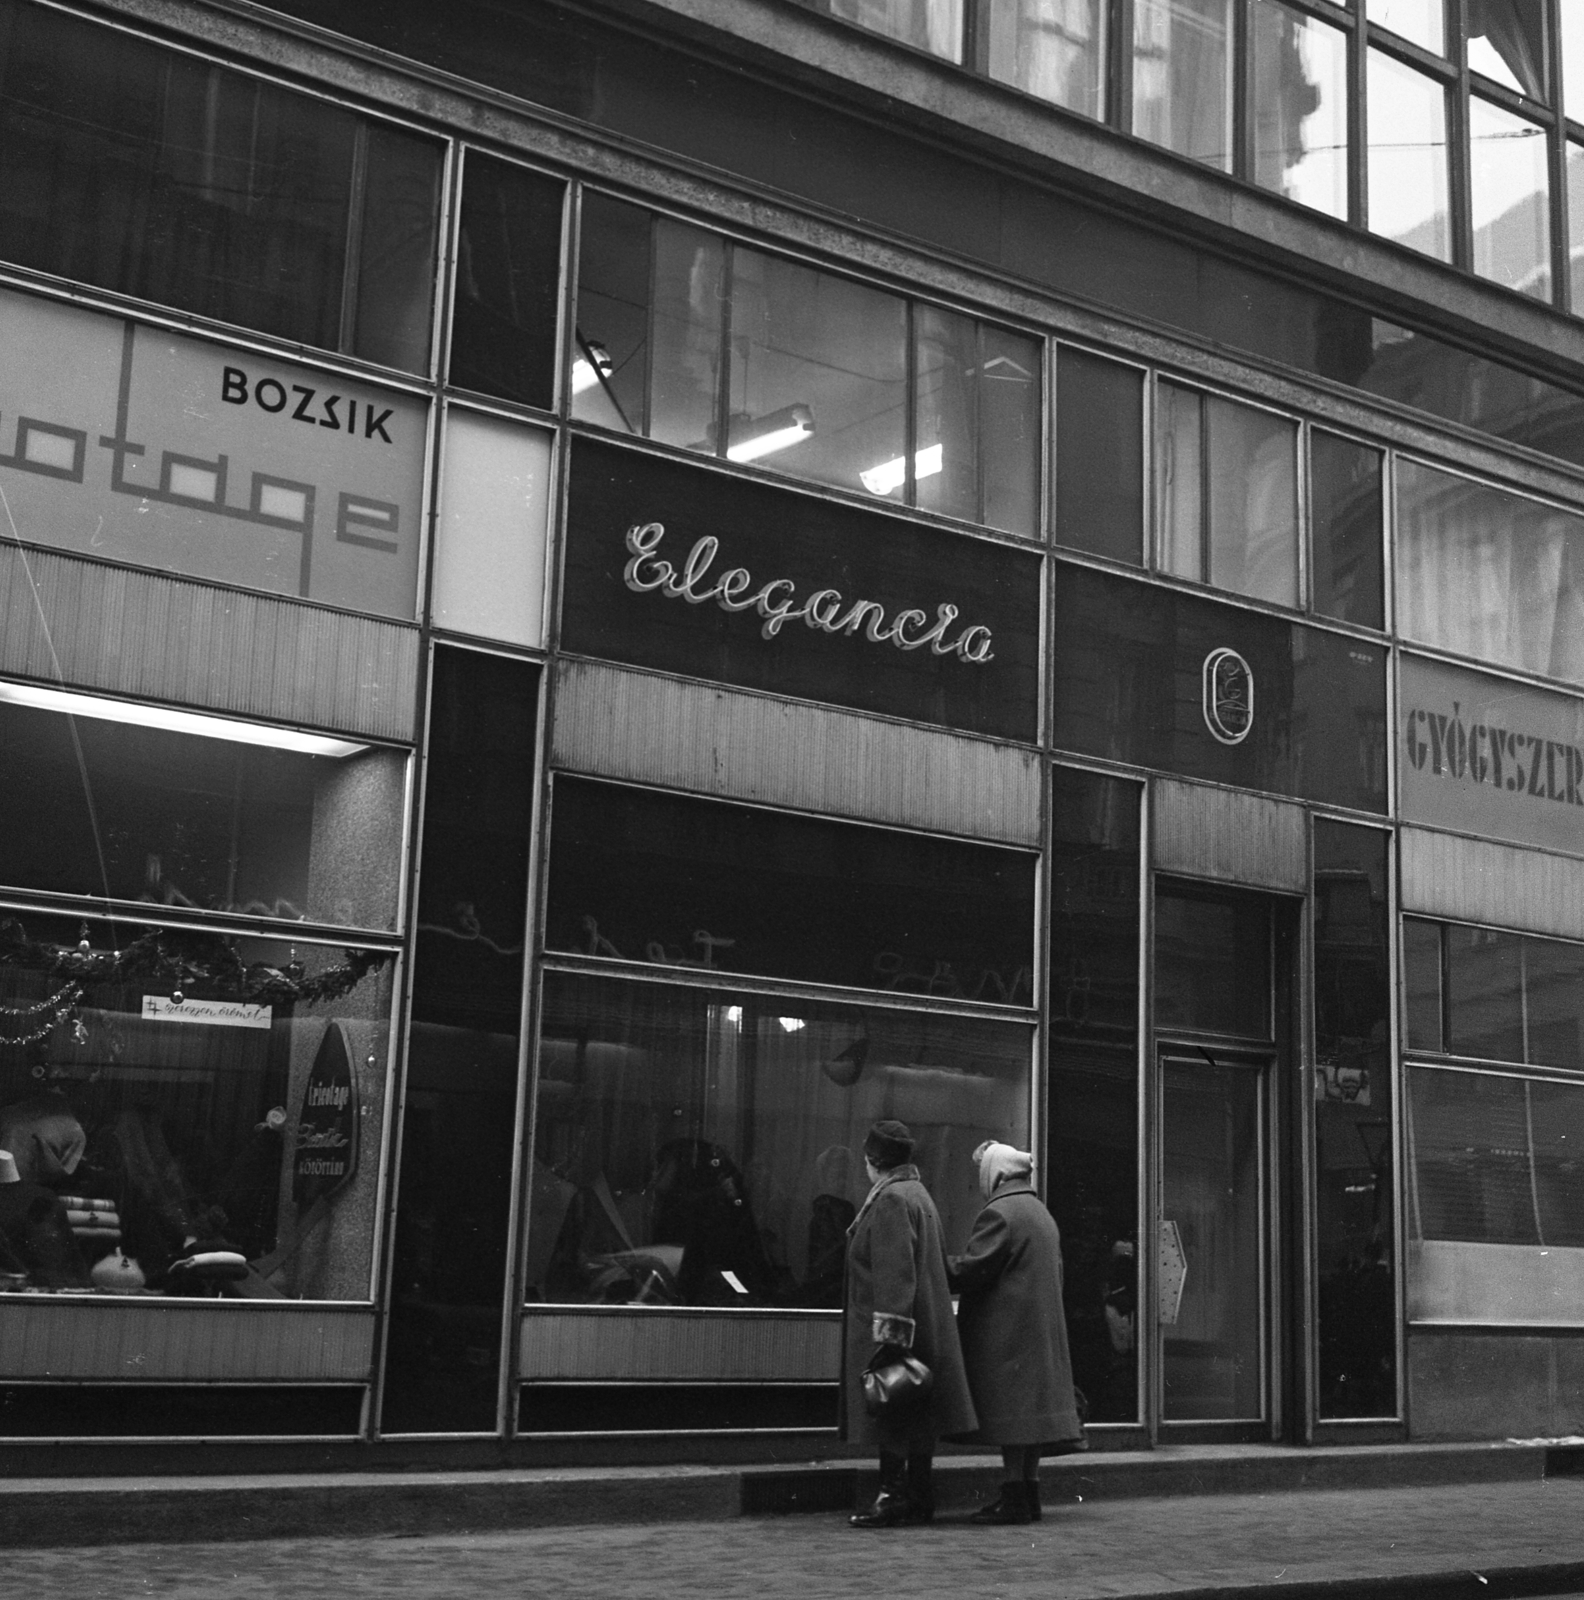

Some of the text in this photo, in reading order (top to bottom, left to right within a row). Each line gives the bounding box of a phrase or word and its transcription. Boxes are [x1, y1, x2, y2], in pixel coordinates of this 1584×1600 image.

[0, 322, 399, 600] otage
[221, 365, 394, 444] BOZSIK
[624, 522, 995, 663] Elegancia
